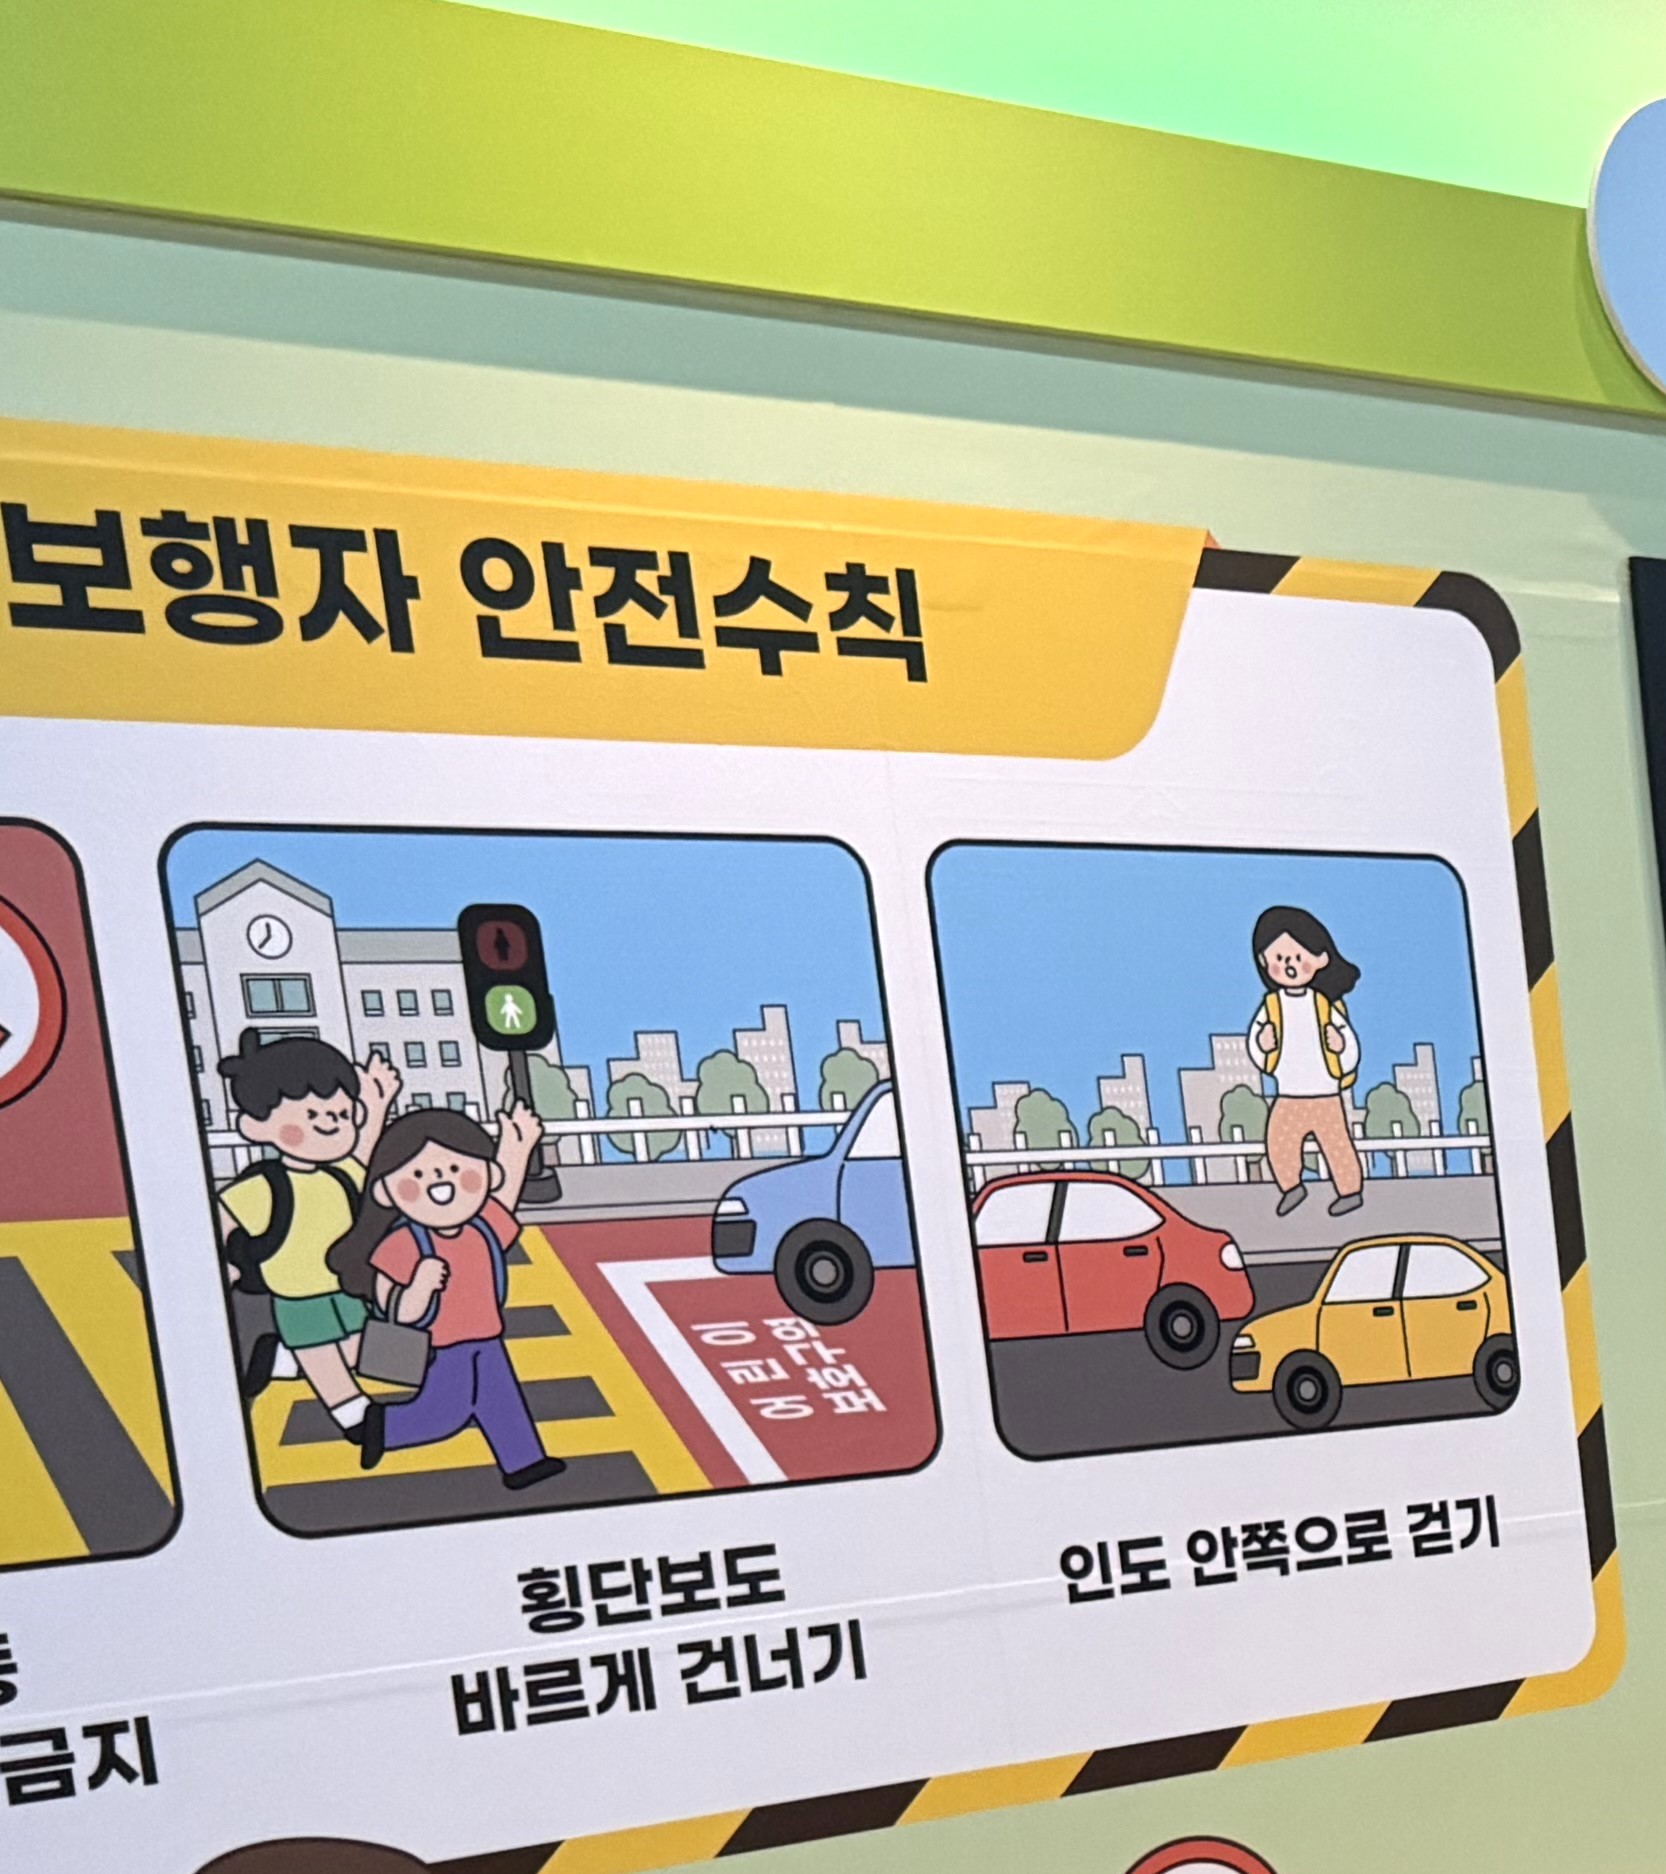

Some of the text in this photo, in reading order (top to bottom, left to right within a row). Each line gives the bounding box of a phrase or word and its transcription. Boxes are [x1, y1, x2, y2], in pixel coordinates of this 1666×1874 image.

[0, 501, 929, 682] 보행자 안전수칙
[517, 1543, 786, 1633] 횡단보도
[1059, 1494, 1501, 1604] 인도 안쪽으로 걷기
[451, 1619, 867, 1736] 바르게 건너기
[0, 1715, 158, 1806] 금지
